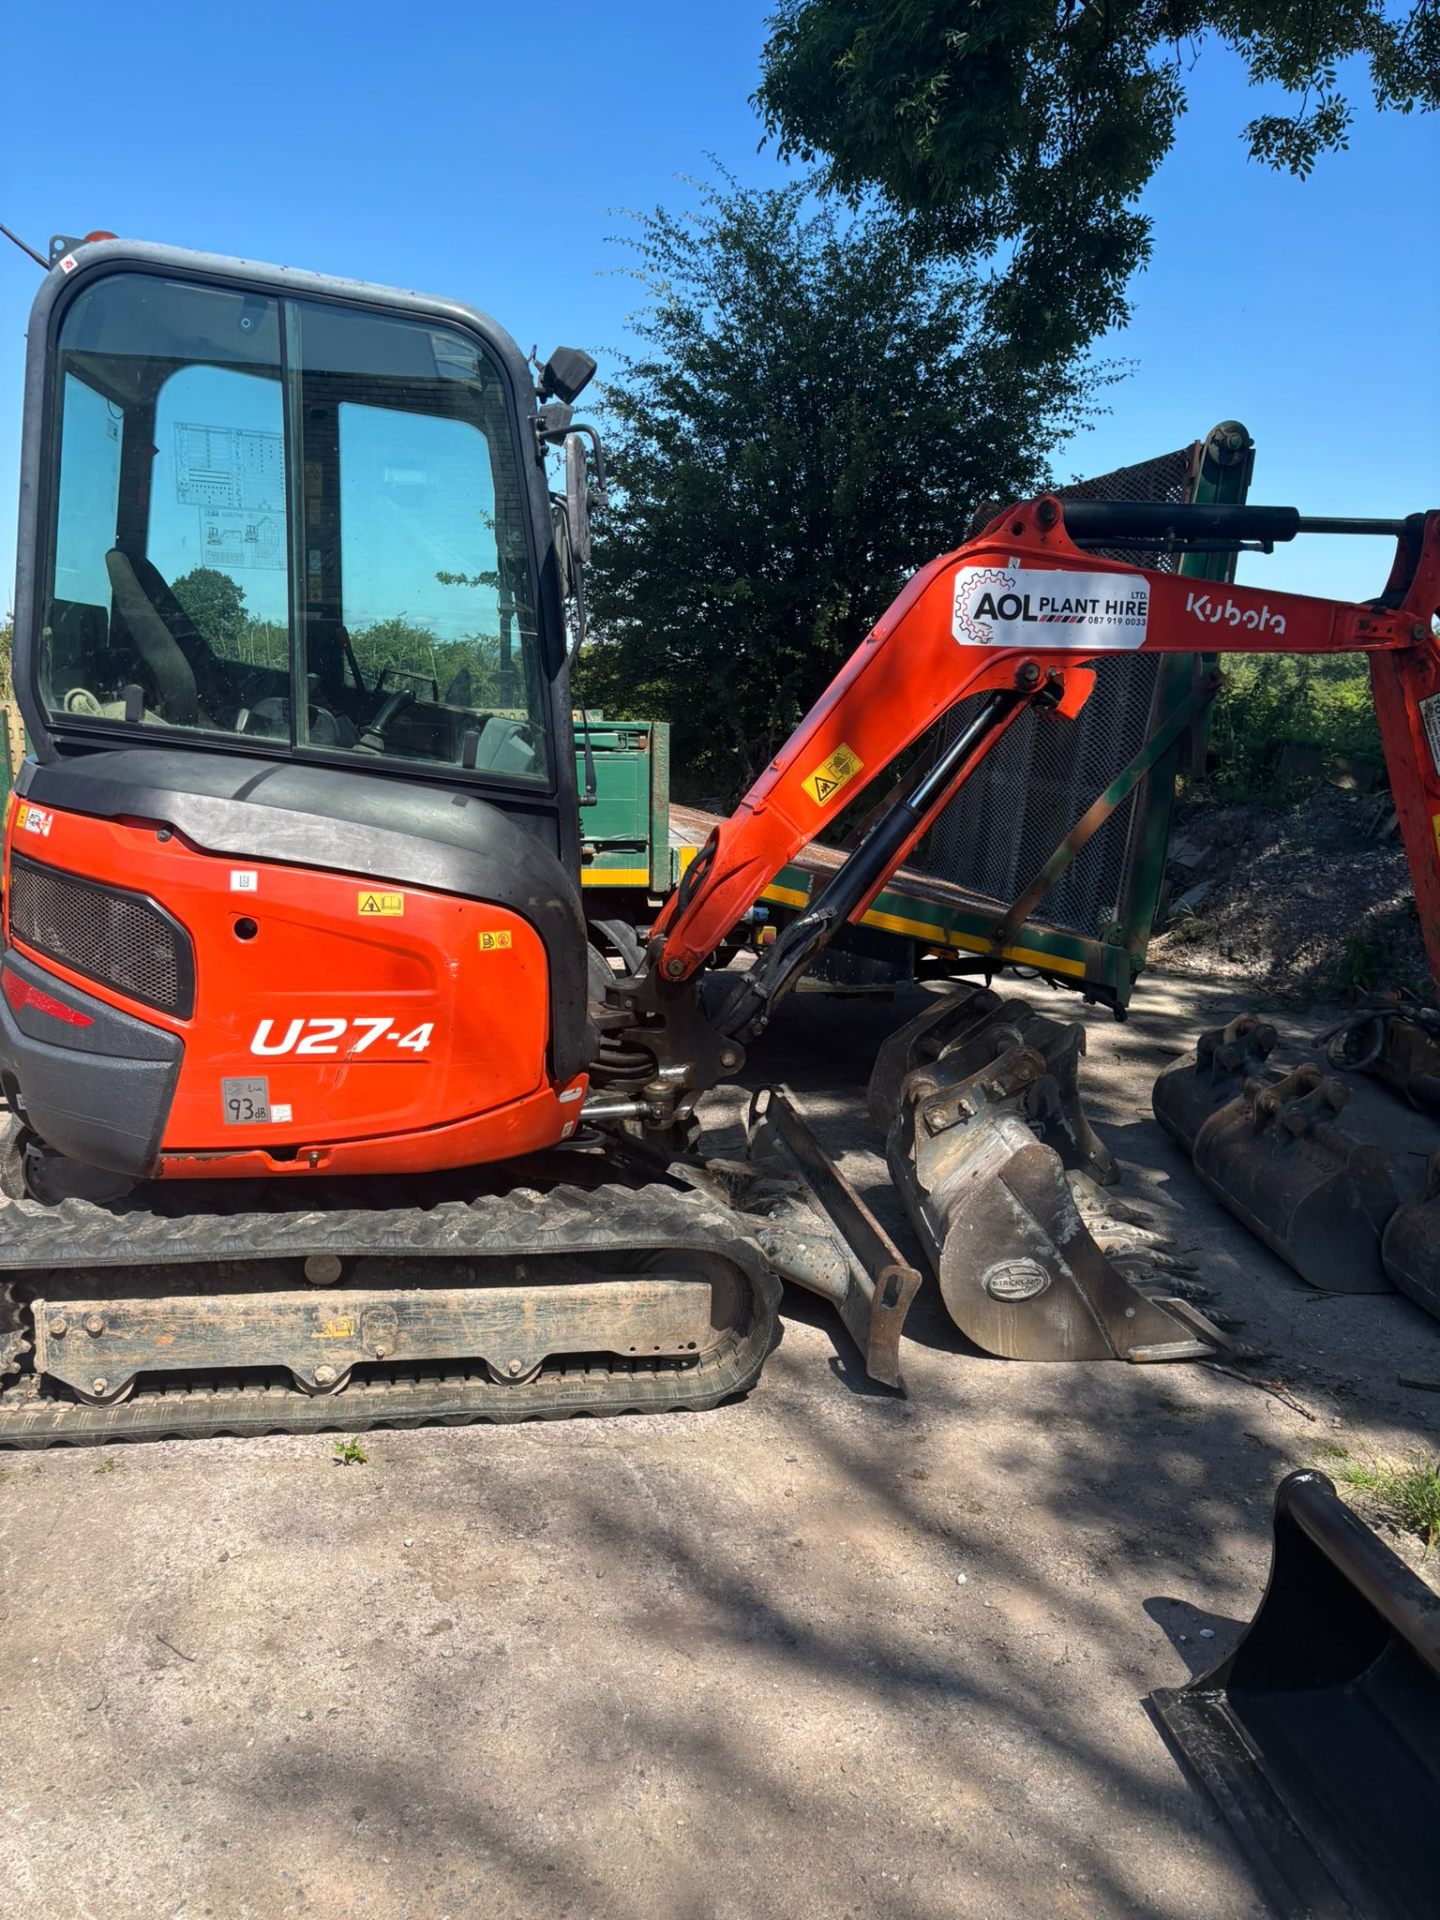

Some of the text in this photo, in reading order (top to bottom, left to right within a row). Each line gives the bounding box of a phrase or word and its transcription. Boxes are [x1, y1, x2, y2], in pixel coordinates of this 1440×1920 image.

[973, 592, 1147, 622] AOL PLANT HIRE
[1131, 591, 1148, 600] LTD.
[1088, 616, 1146, 627] 087 919 0033
[1186, 592, 1286, 635] Kubota
[250, 1017, 435, 1056] U27-4
